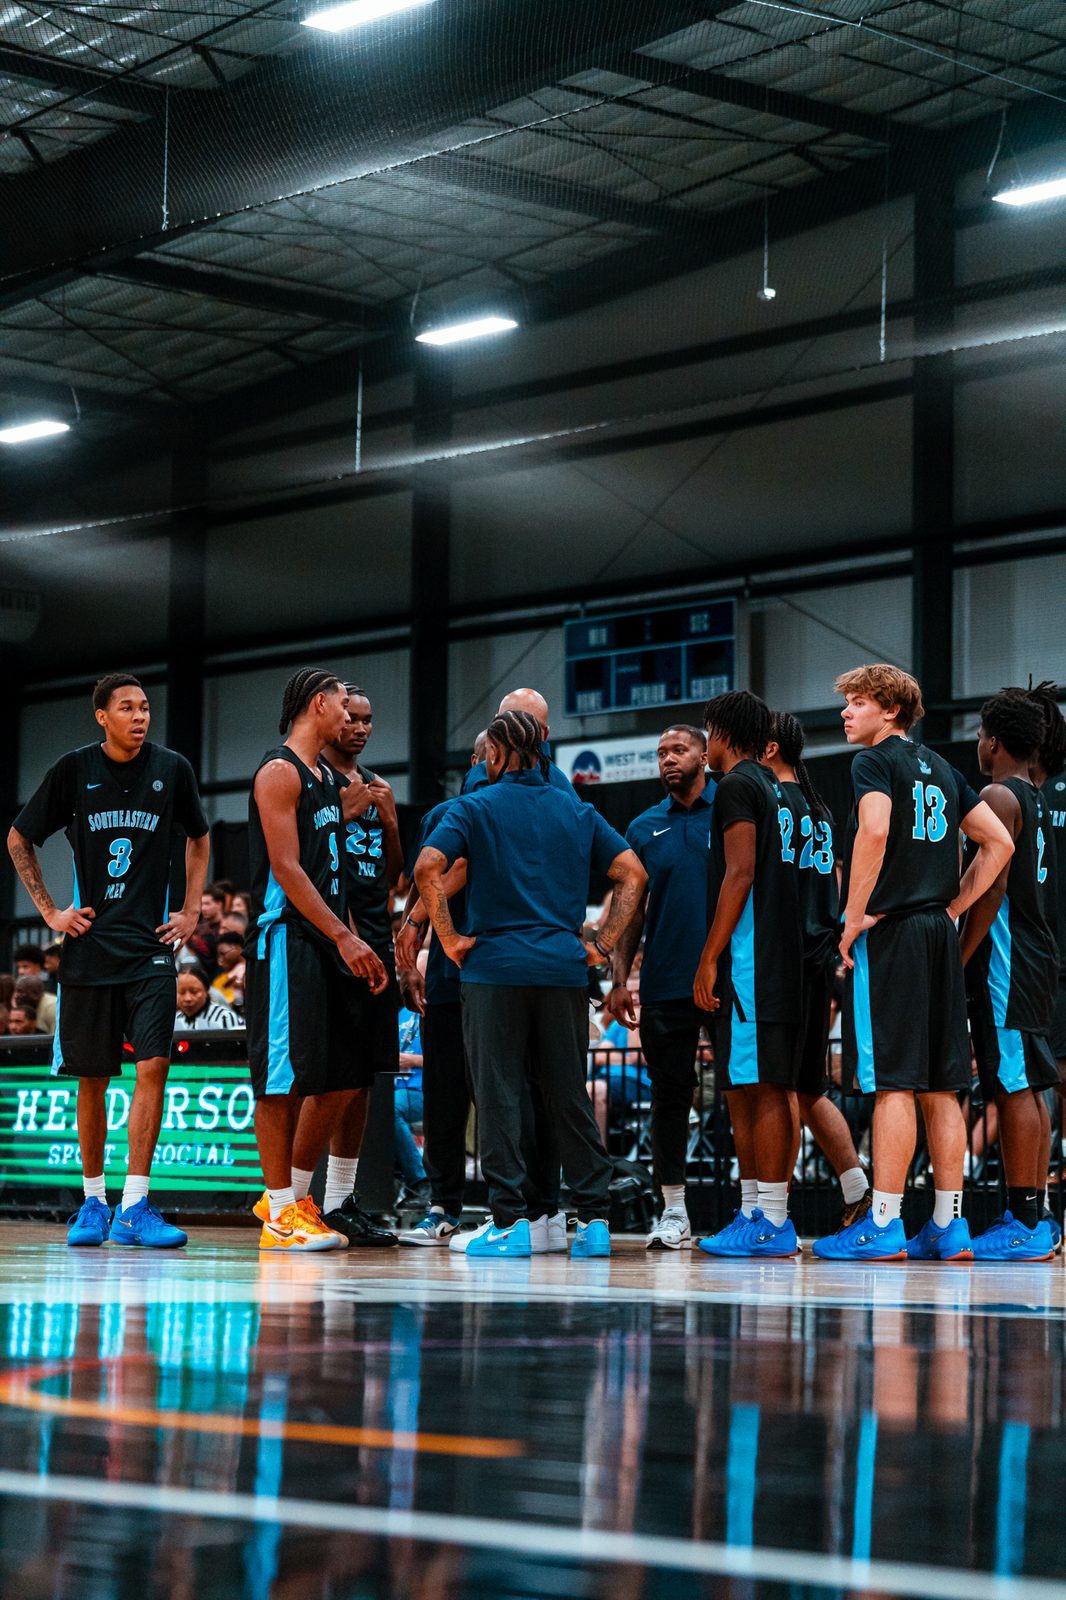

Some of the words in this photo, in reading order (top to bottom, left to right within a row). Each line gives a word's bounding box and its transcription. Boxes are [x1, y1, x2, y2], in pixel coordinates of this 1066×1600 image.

[604, 752, 636, 768] WEST
[88, 810, 159, 832] SOUTHEASTERN
[912, 780, 948, 842] 13
[107, 838, 133, 877] 3
[799, 815, 834, 874] 23
[13, 1085, 257, 1131] HEDRSO
[48, 1144, 116, 1165] SPT
[152, 1144, 235, 1166] SOCIAL
